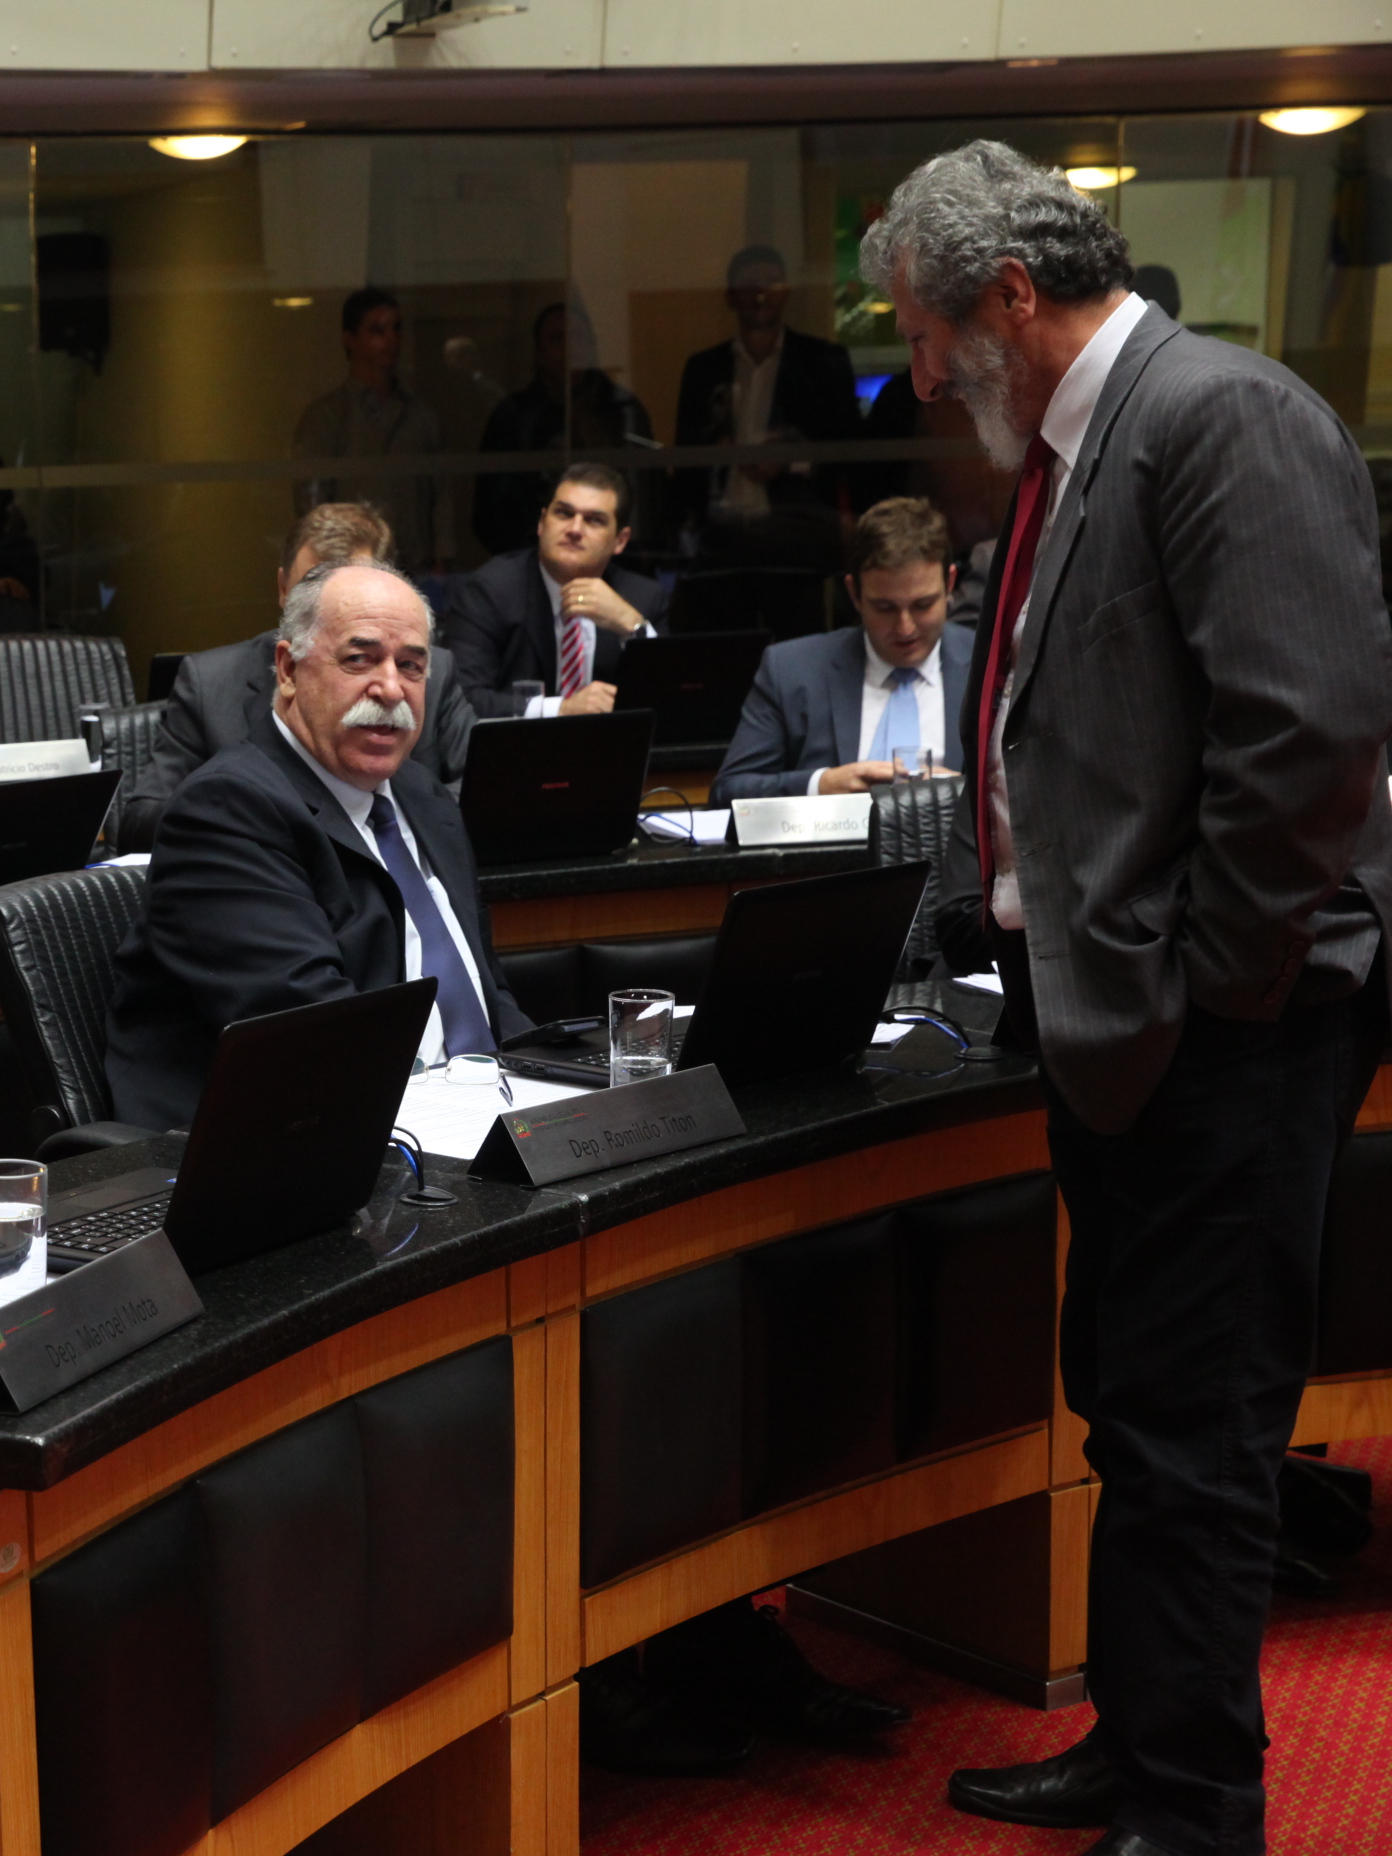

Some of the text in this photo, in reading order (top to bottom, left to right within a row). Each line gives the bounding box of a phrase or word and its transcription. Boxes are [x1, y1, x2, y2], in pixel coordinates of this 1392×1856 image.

[569, 1138, 604, 1159] Dep.
[604, 1120, 661, 1149] Romildo
[659, 1113, 697, 1135] Titon
[45, 1297, 159, 1368] Dep. Manoel Mota
